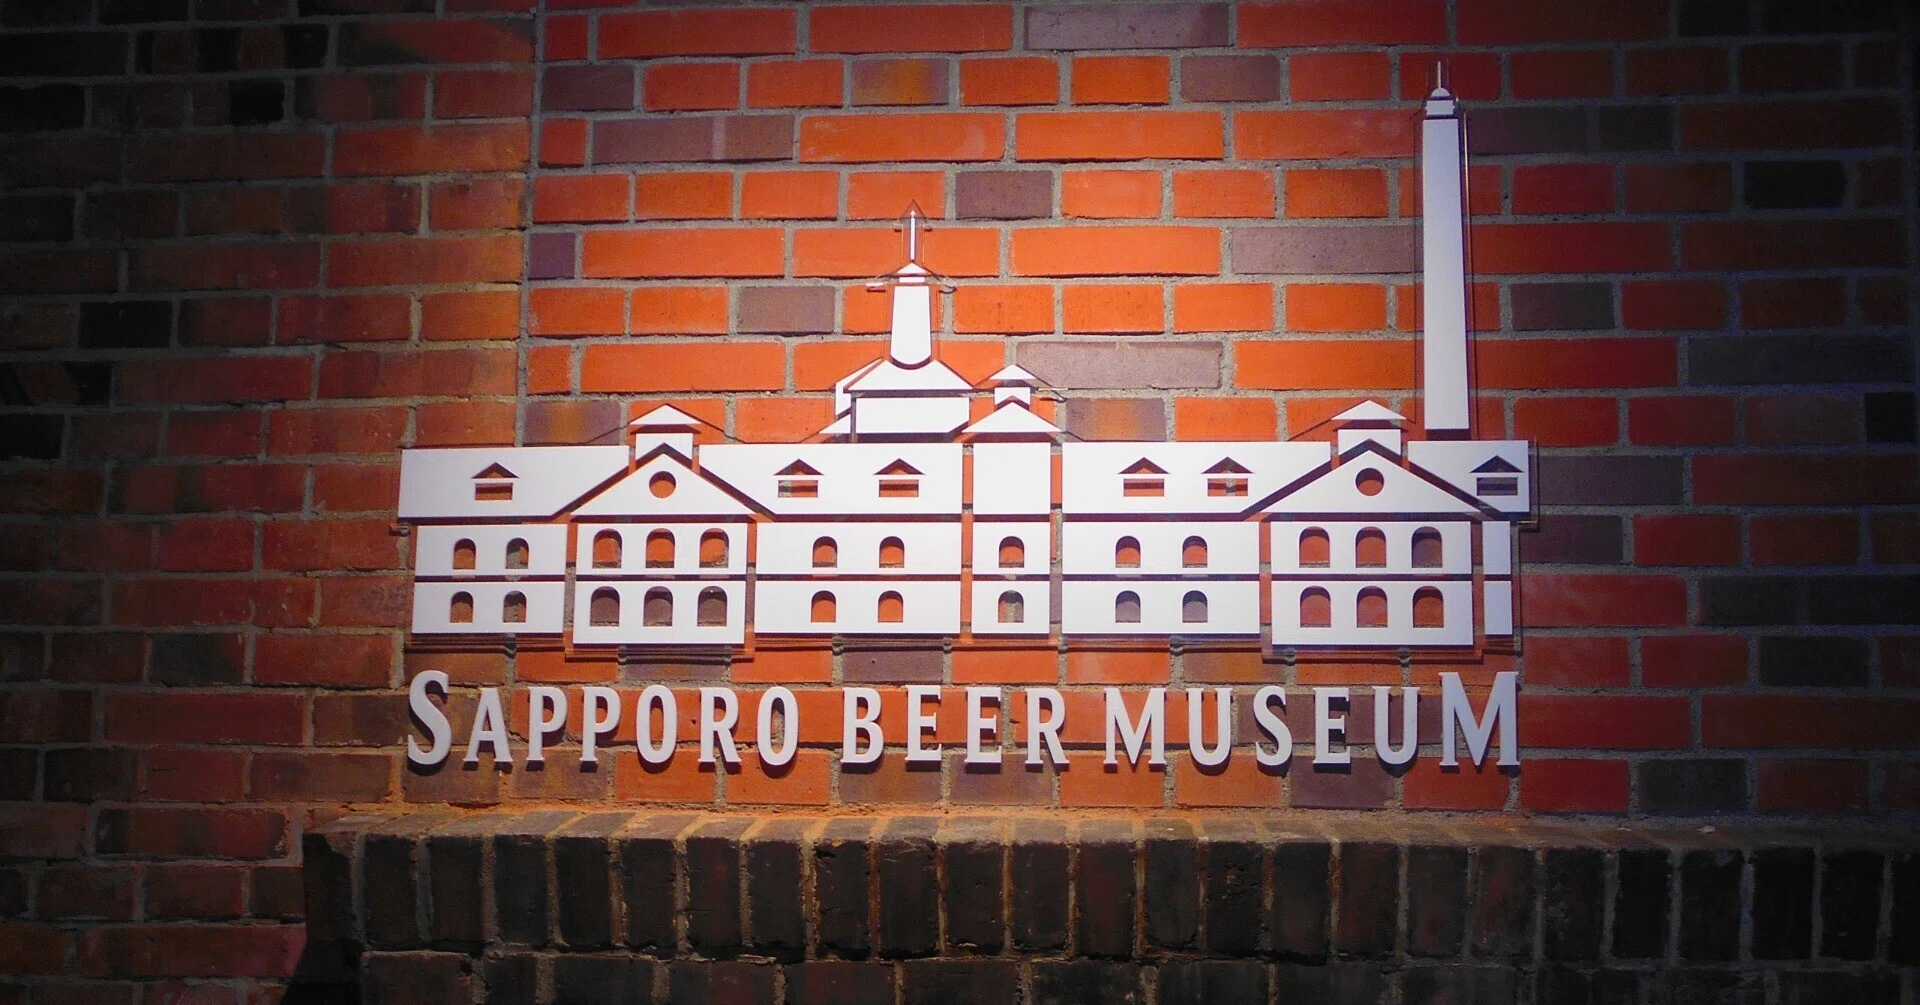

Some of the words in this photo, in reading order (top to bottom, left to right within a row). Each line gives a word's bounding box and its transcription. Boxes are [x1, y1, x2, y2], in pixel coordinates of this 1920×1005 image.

[408, 669, 799, 765] SAPPORO
[839, 684, 1070, 764] BEER
[1102, 671, 1519, 767] MUSEUM
